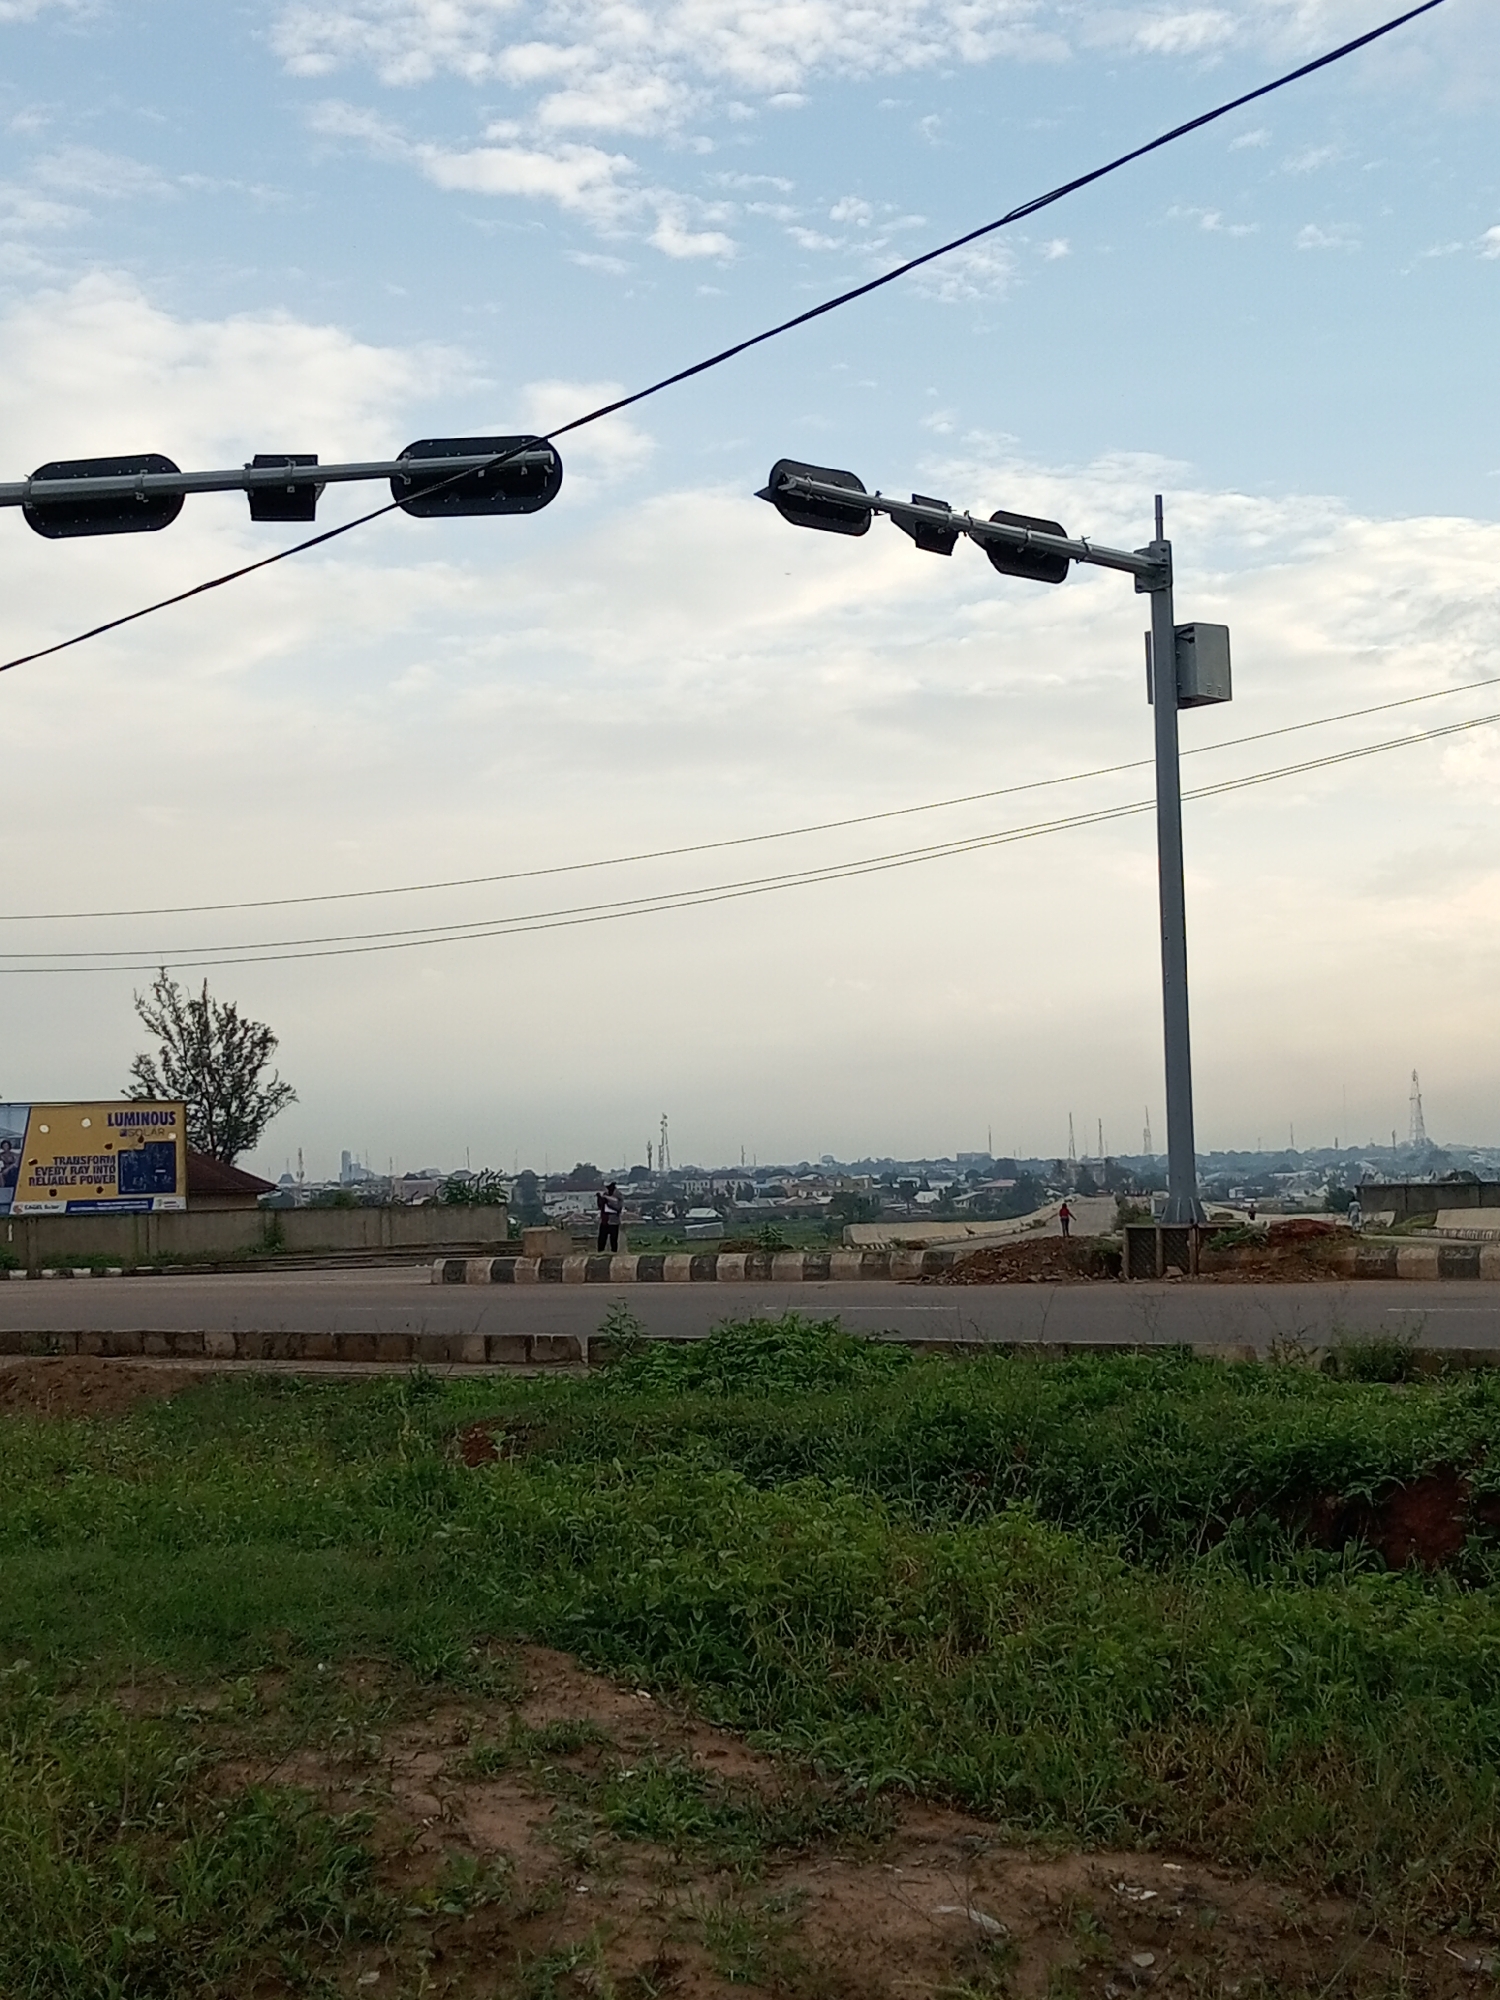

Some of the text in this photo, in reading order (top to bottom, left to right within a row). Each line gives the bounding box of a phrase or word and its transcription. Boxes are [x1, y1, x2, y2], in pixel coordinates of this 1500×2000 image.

[107, 1111, 176, 1126] LUMINOUS
[53, 1155, 116, 1165] TRANSFORM
[35, 1164, 116, 1176] EVERY RAY INTO
[29, 1175, 116, 1186] RELIABLE POWER
